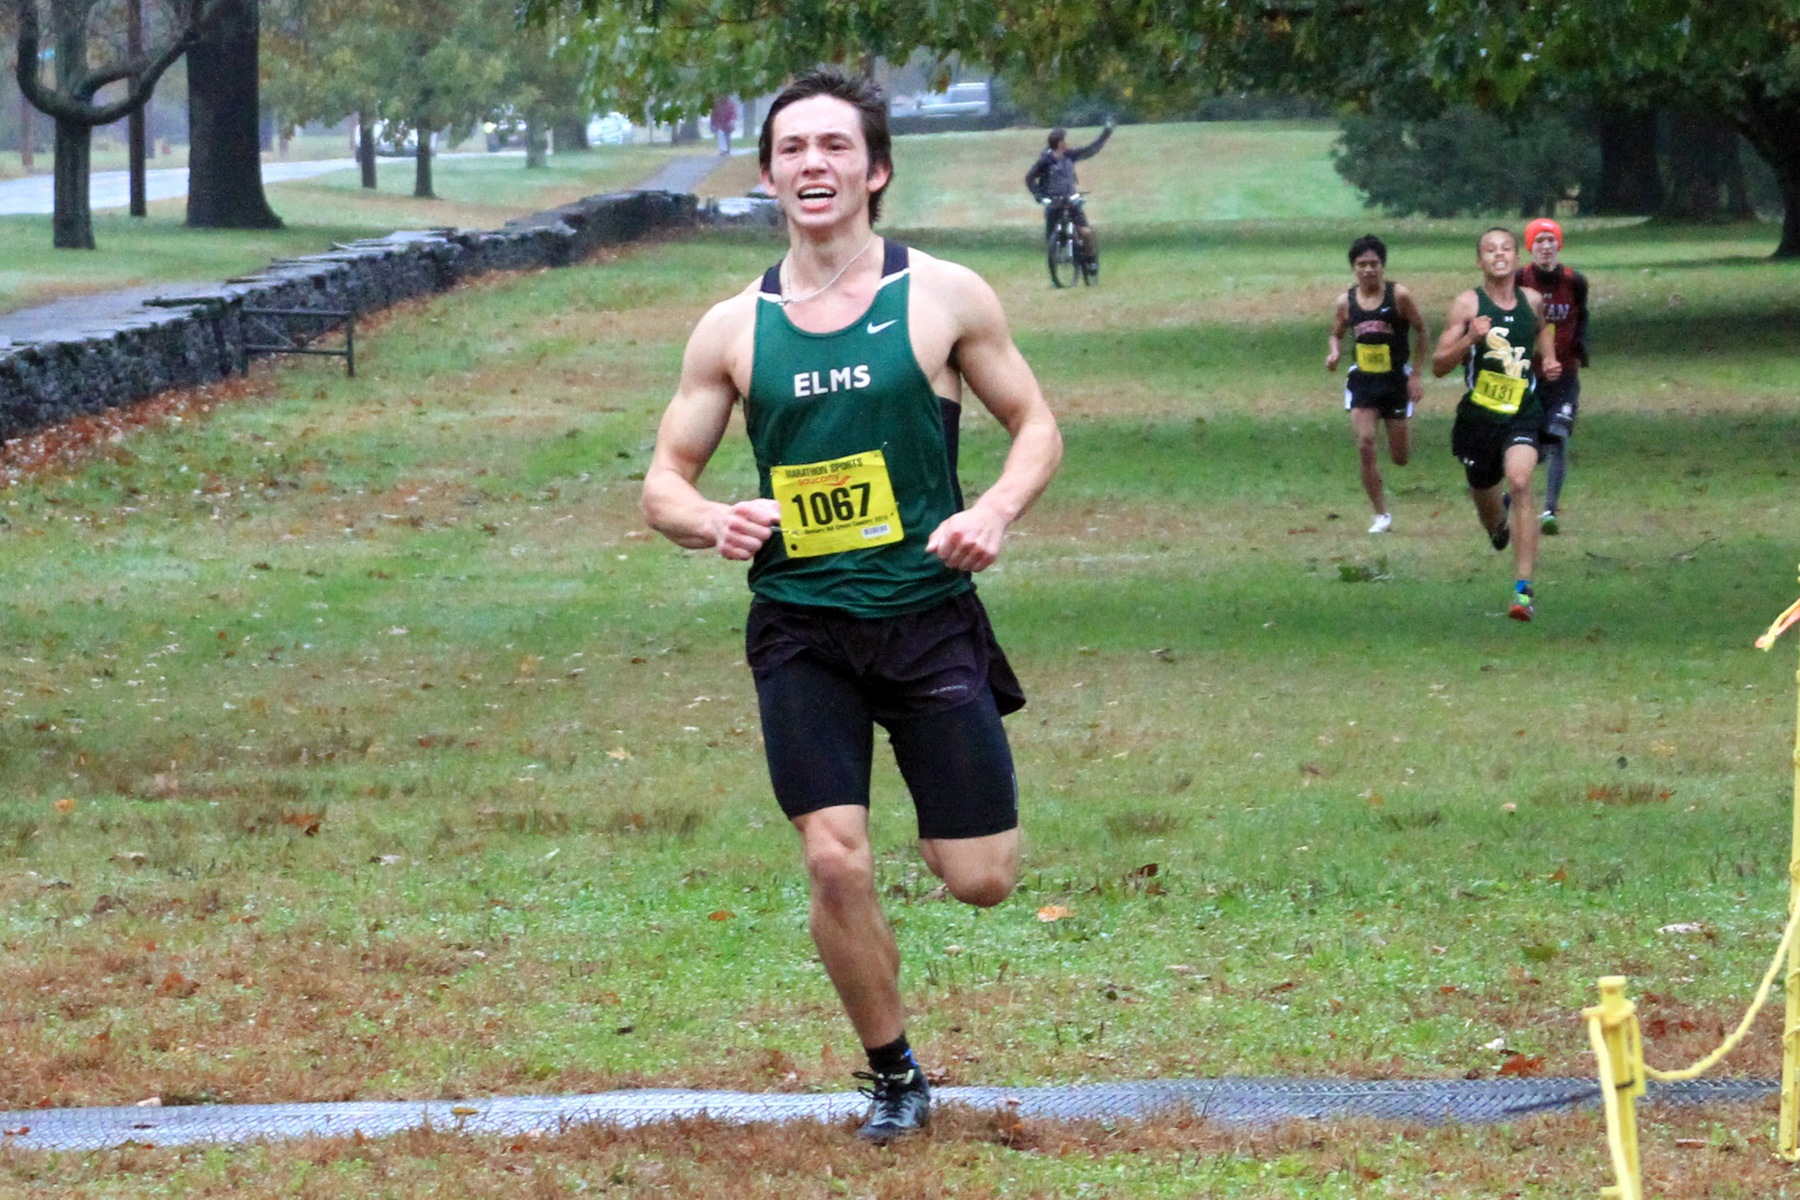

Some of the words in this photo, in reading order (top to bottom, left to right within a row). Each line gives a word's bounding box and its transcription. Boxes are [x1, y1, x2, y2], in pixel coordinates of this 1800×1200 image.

[794, 364, 871, 397] ELMS
[1484, 383, 1514, 401] 1131
[785, 465, 828, 478] MARATHON
[830, 458, 863, 473] SPORTS
[792, 482, 870, 527] 1067
